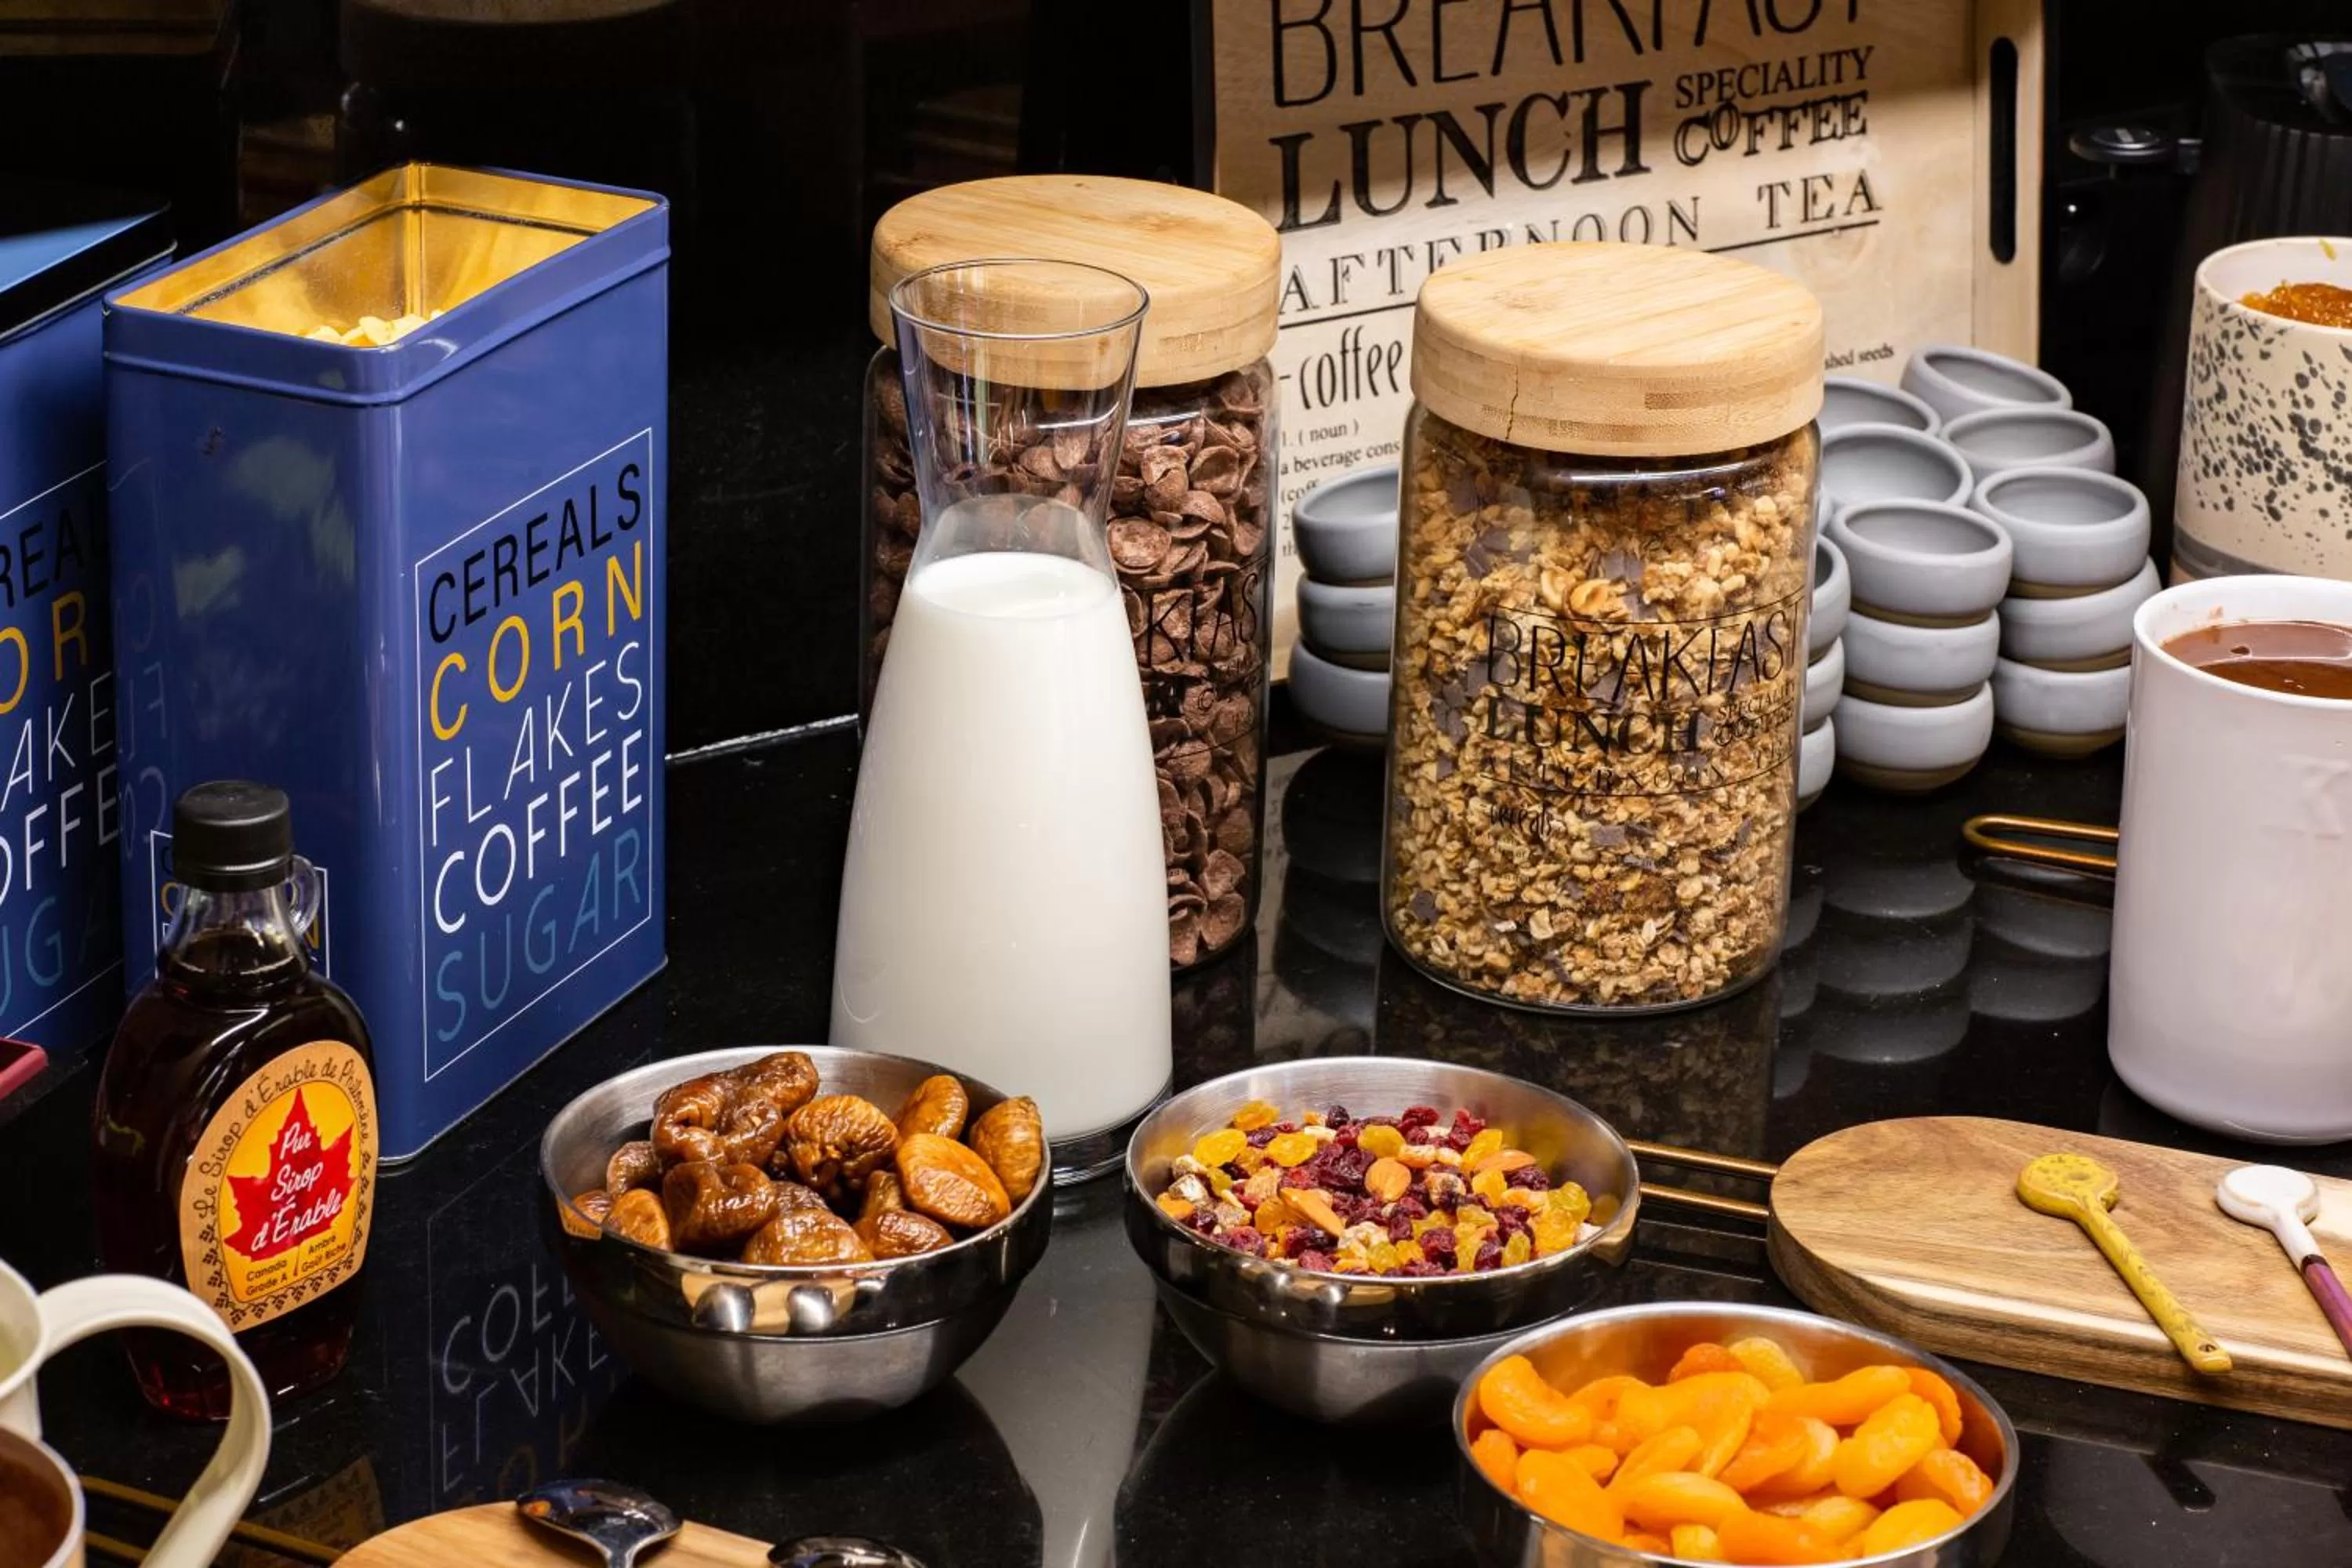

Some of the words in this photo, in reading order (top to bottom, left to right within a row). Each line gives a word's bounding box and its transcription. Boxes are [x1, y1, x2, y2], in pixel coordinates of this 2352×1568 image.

[1675, 45, 1875, 109] SPECIALITY
[1269, 80, 1653, 233] LUNCH
[1674, 91, 1869, 166] COFFEE
[1758, 168, 1883, 229] TEA
[1294, 447, 1362, 472] beverage
[428, 463, 641, 644] CEREALS
[430, 540, 642, 741] CORN
[432, 642, 642, 848] FLAKES
[1481, 693, 1700, 753] LUNCH
[434, 730, 642, 935] COFFEE
[437, 827, 641, 1043] SUGAR
[321, 1057, 338, 1079] de
[199, 1122, 241, 1179] Sirop
[279, 1122, 312, 1160] Pur
[193, 1183, 218, 1220] Le
[270, 1162, 324, 1201] Sirop
[251, 1188, 342, 1252] d'Érable
[245, 1278, 278, 1296] Grade
[280, 1272, 287, 1283] A
[246, 1260, 287, 1282] Canada
